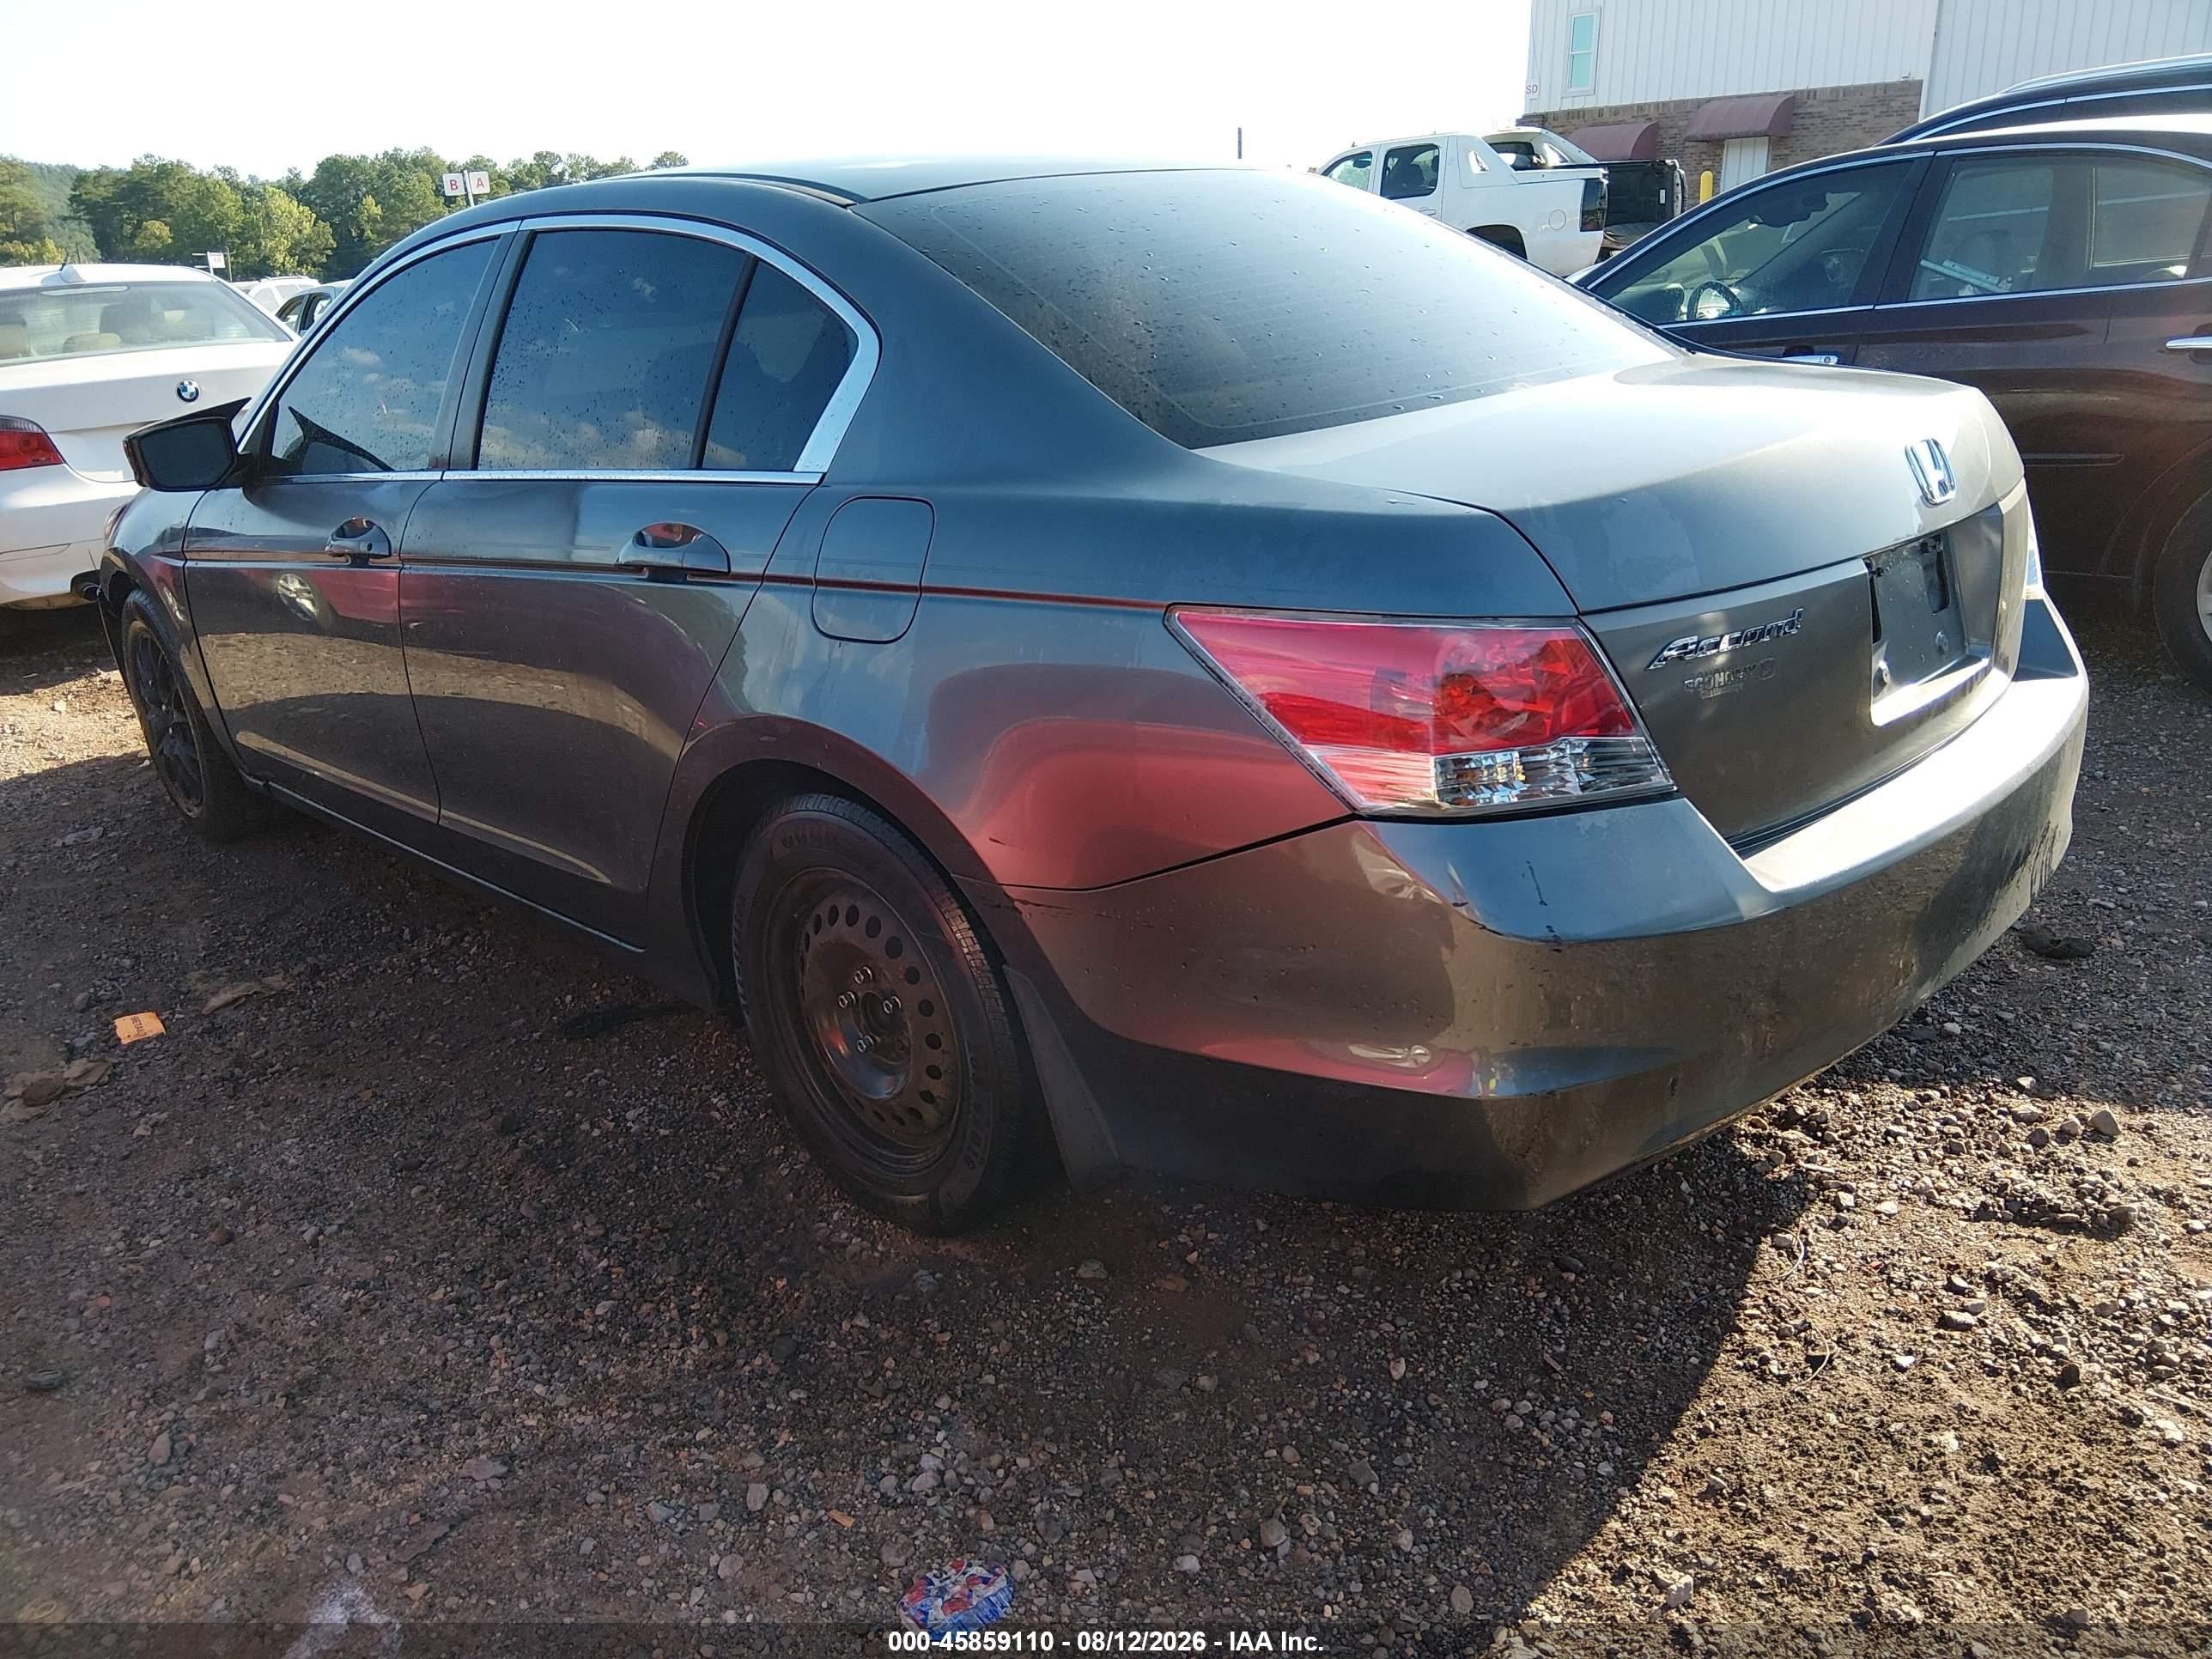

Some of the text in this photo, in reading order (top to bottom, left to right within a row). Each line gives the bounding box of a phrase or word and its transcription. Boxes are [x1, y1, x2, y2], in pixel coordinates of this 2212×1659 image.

[1526, 84, 1538, 95] SD
[449, 179, 459, 191] B
[477, 177, 485, 189] A
[1644, 608, 1804, 672] Accord
